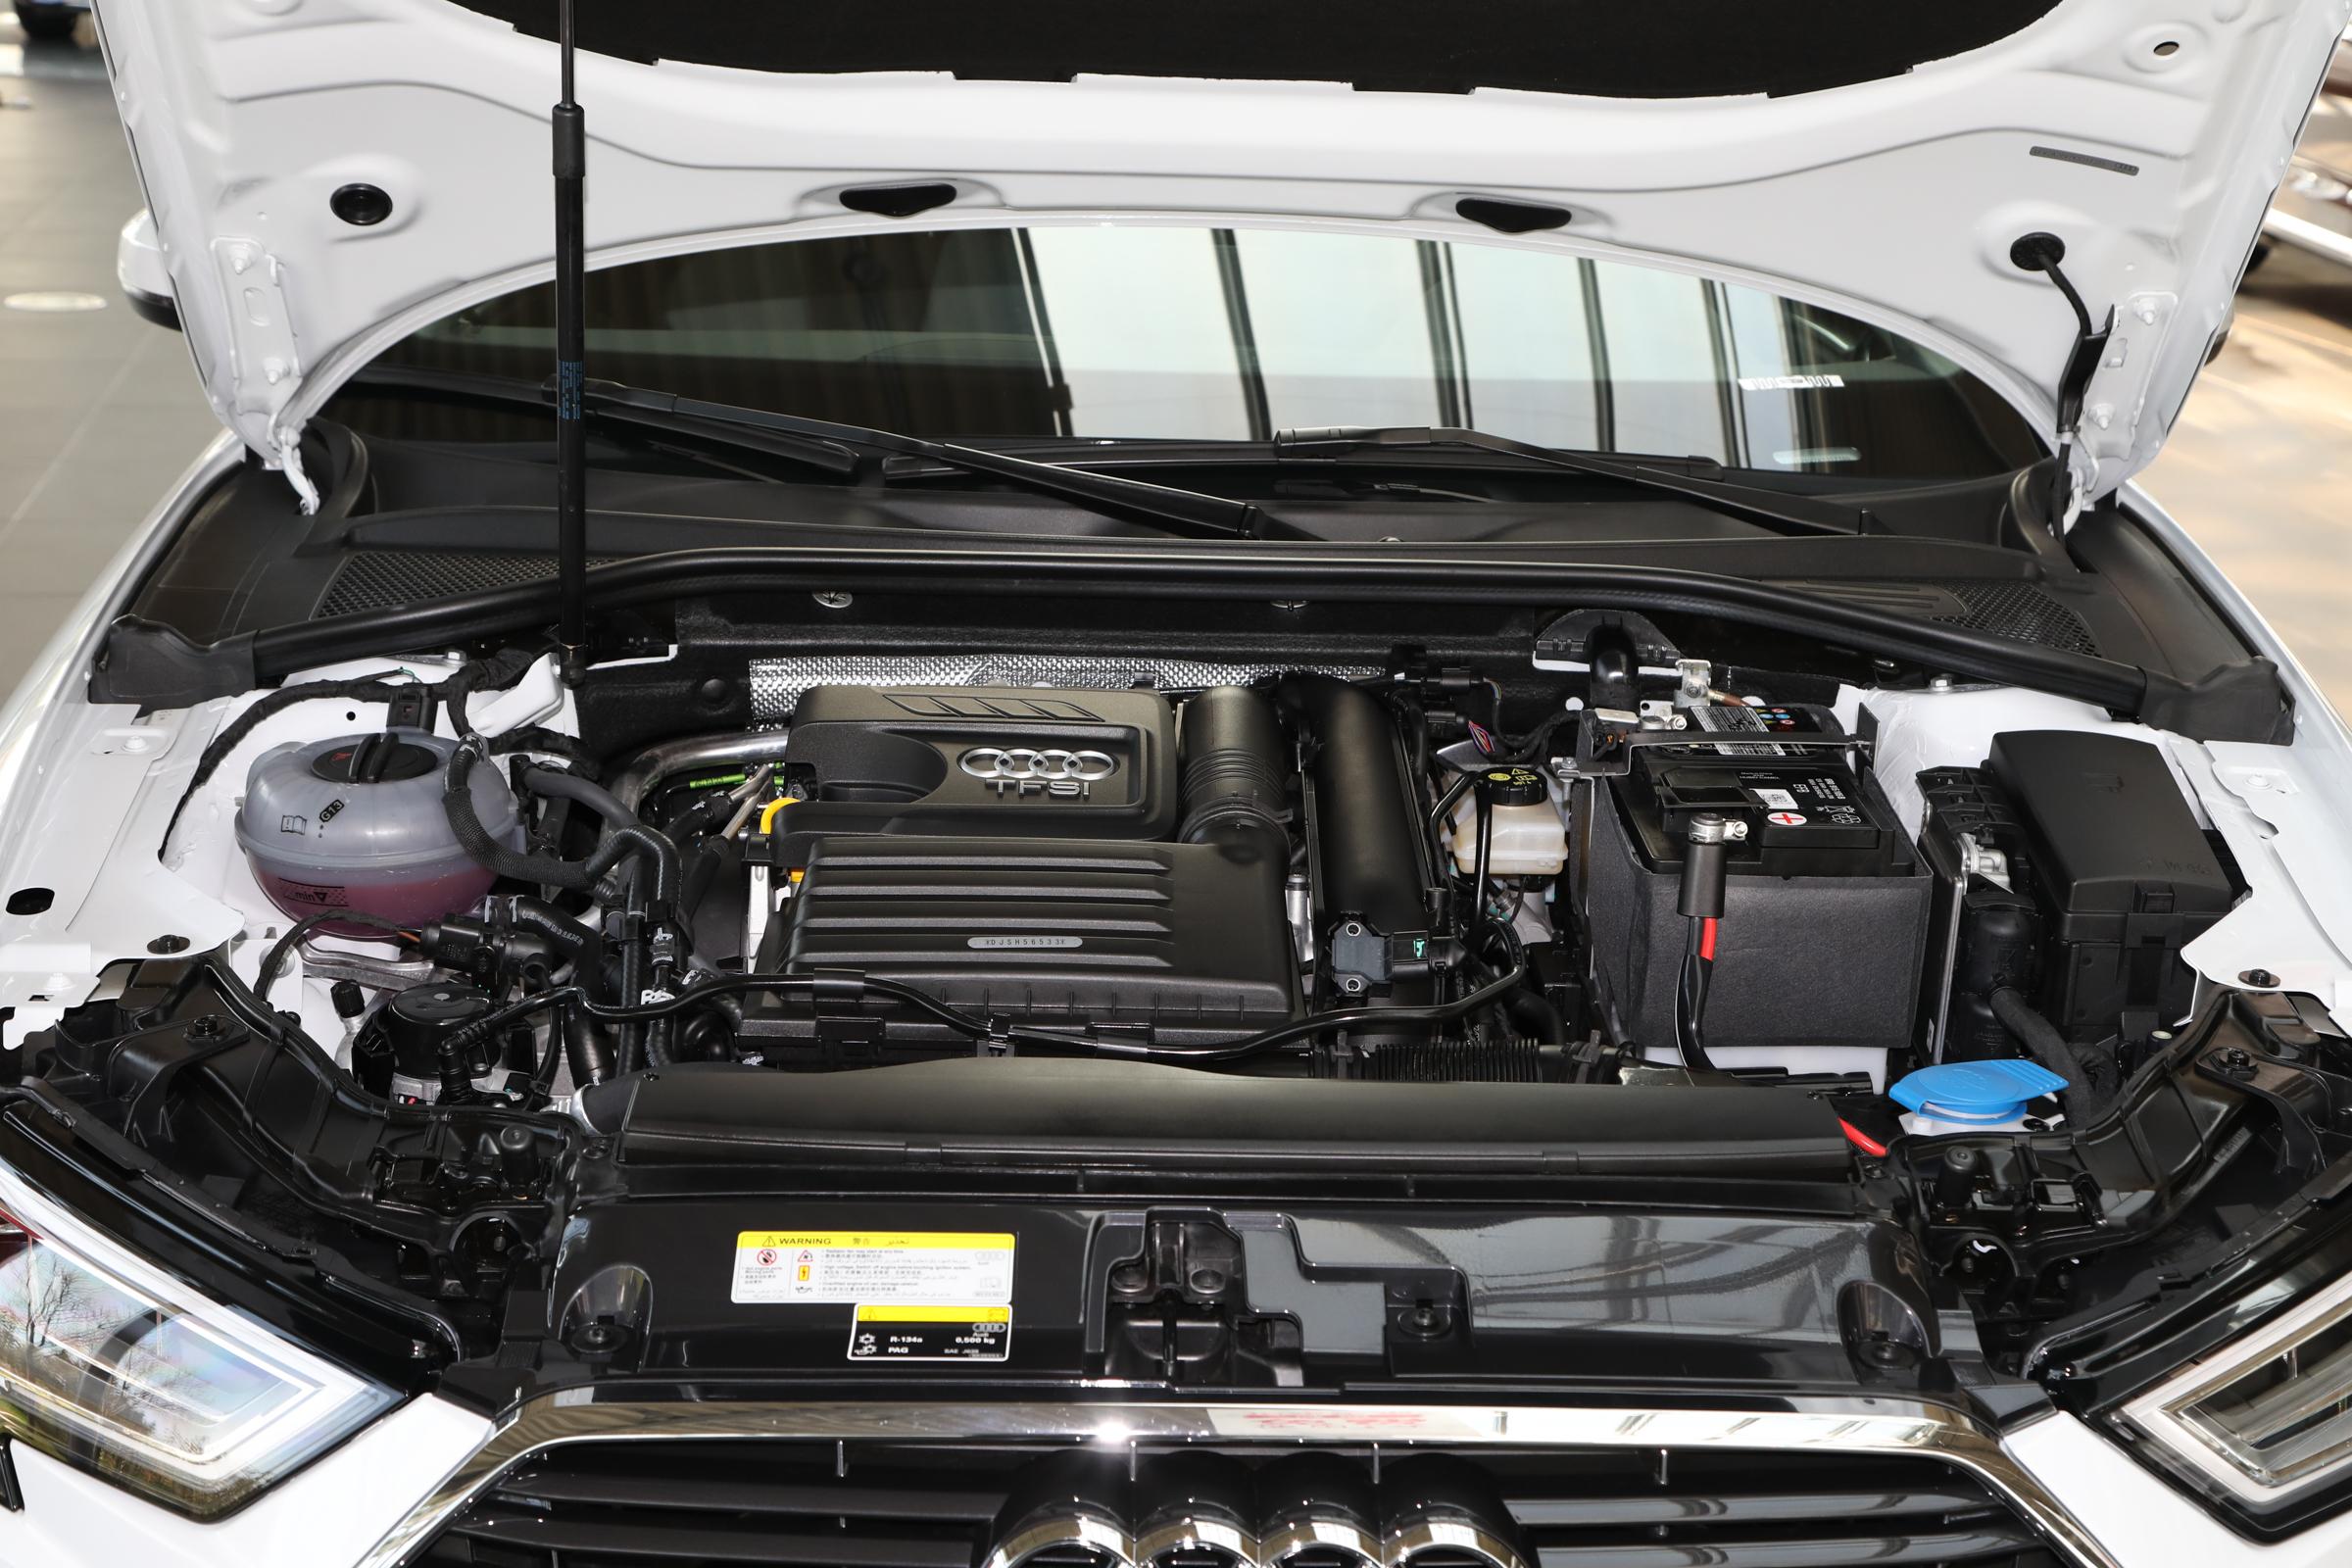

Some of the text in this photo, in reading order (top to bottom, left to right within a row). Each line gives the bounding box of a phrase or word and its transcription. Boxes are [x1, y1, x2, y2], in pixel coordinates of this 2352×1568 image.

[985, 779, 1090, 798] TFSI
[320, 801, 343, 821] G13
[295, 891, 316, 903] min
